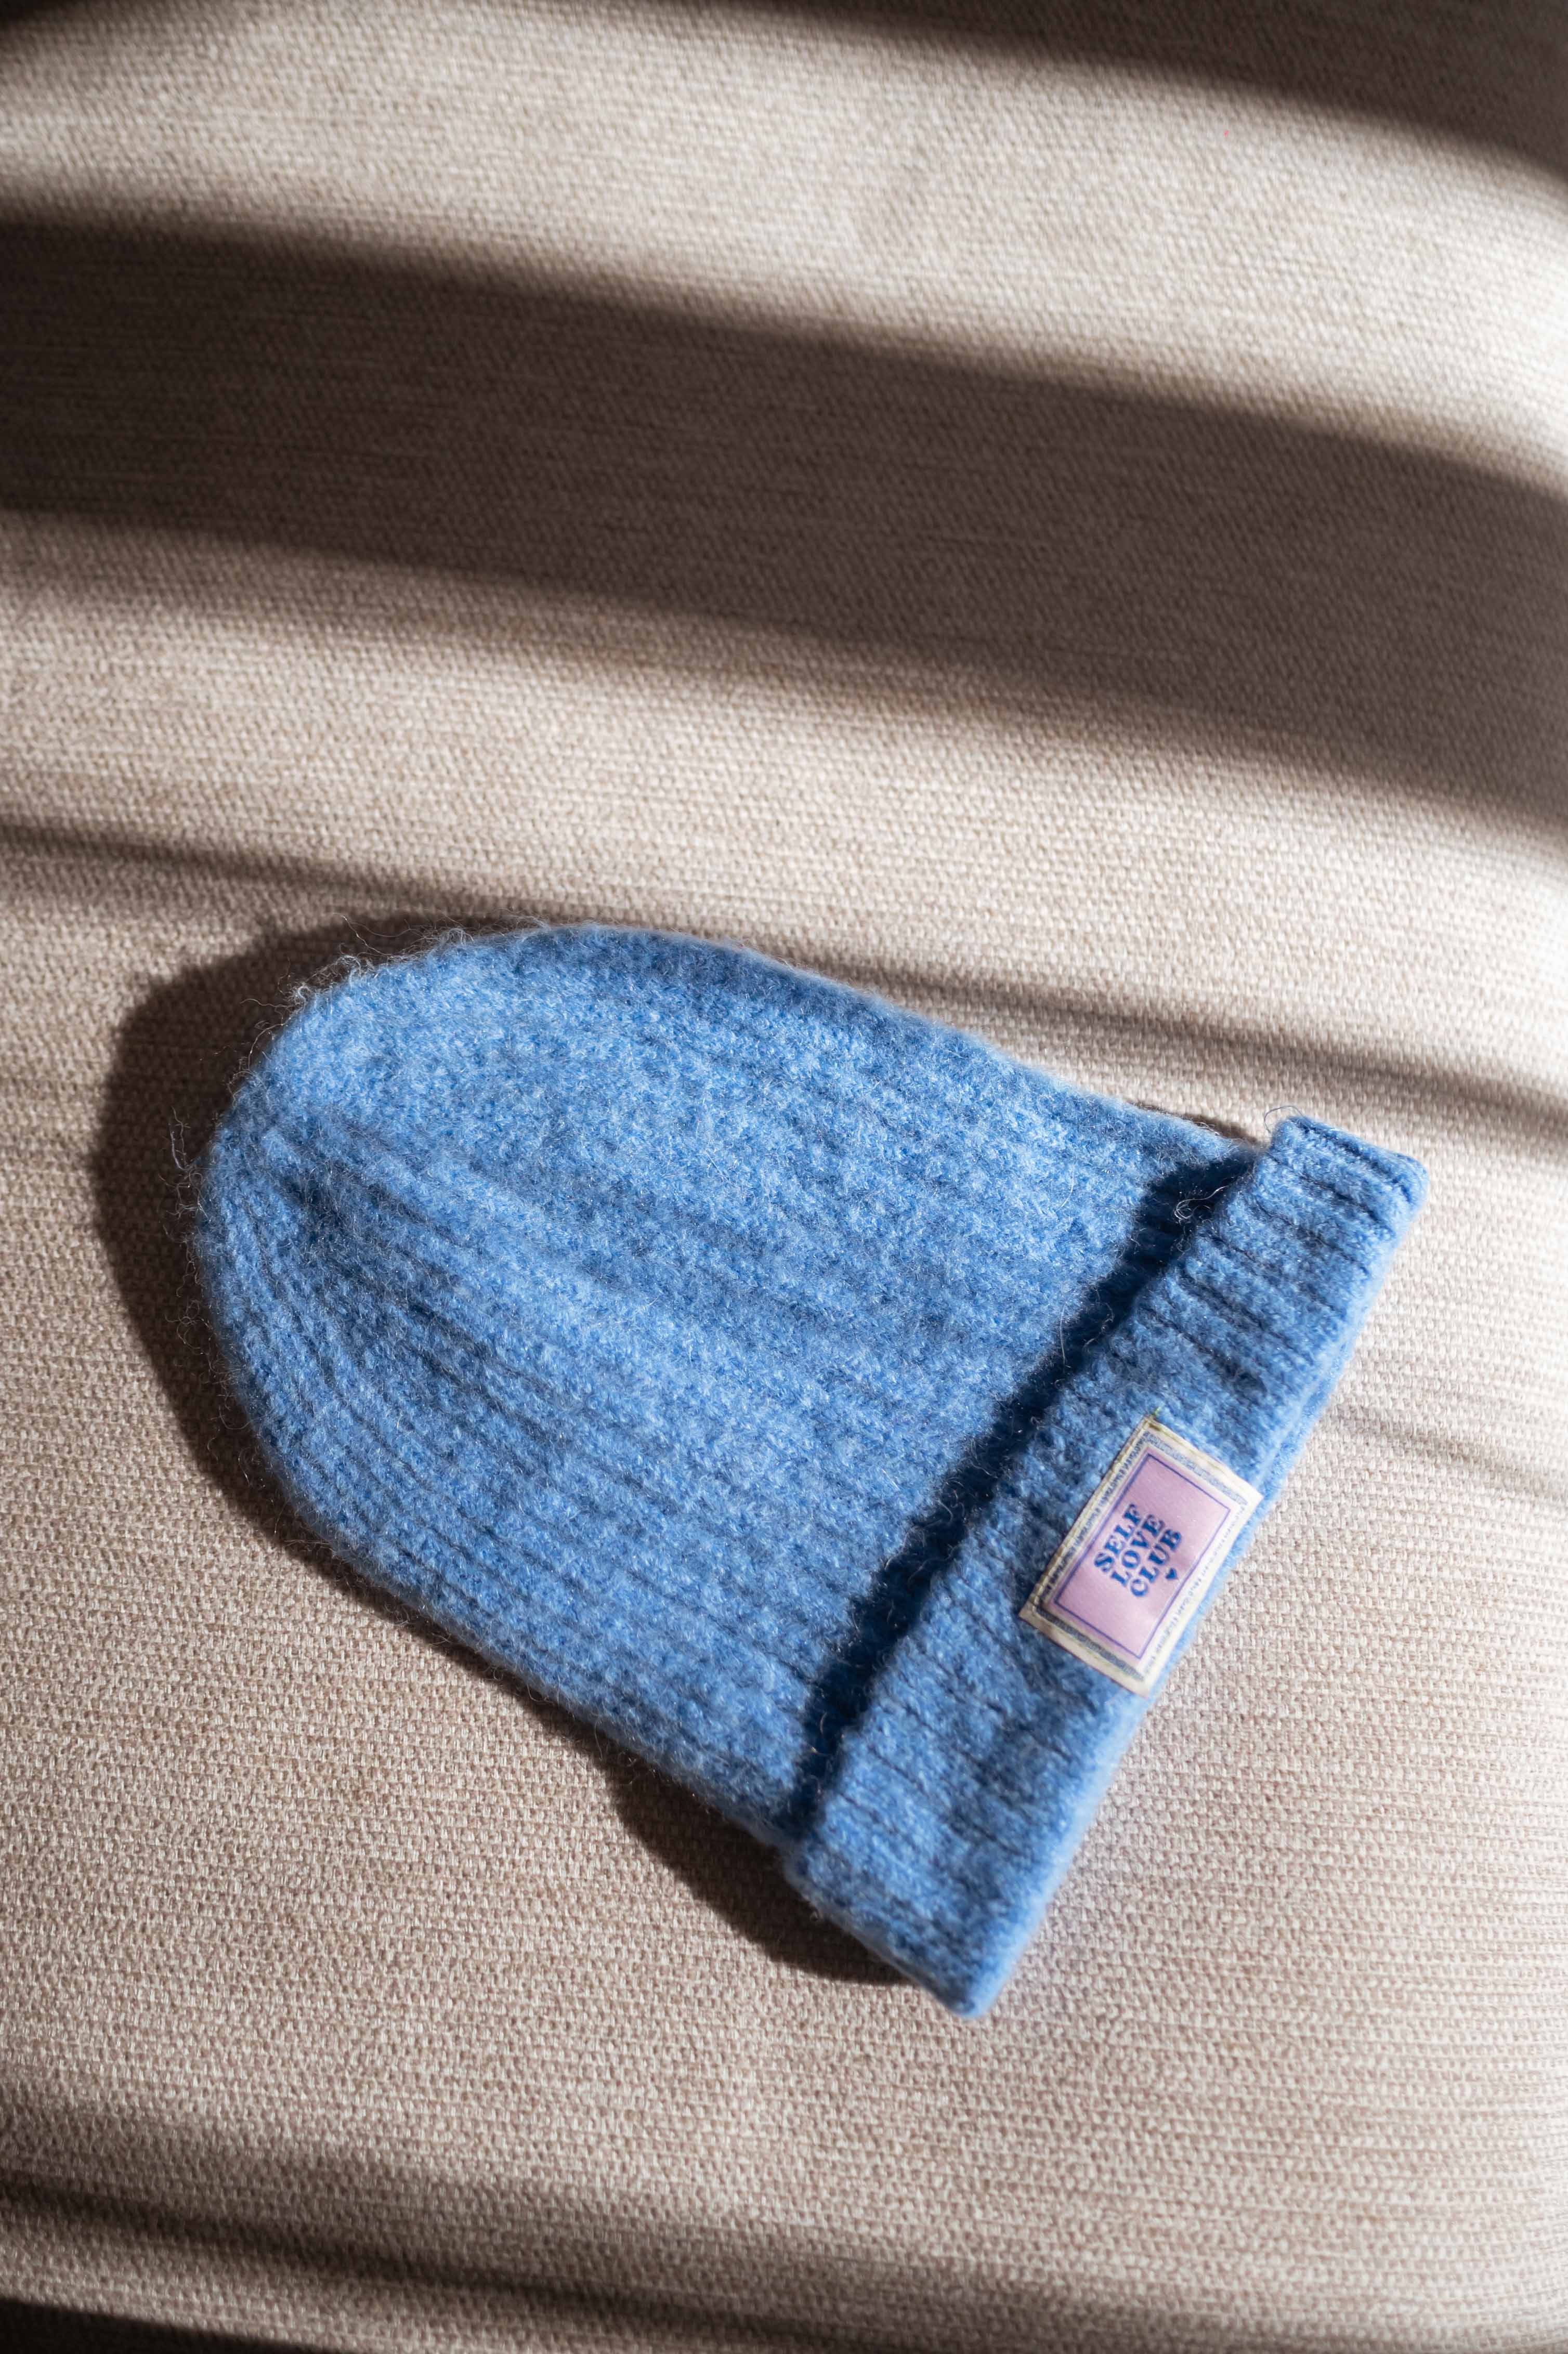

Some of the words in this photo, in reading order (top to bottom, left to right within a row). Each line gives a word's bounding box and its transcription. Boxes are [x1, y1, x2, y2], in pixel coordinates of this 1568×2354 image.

[1094, 1503, 1141, 1573] SELF
[1110, 1514, 1165, 1587] LOVE
[1130, 1529, 1182, 1597] CLUB
